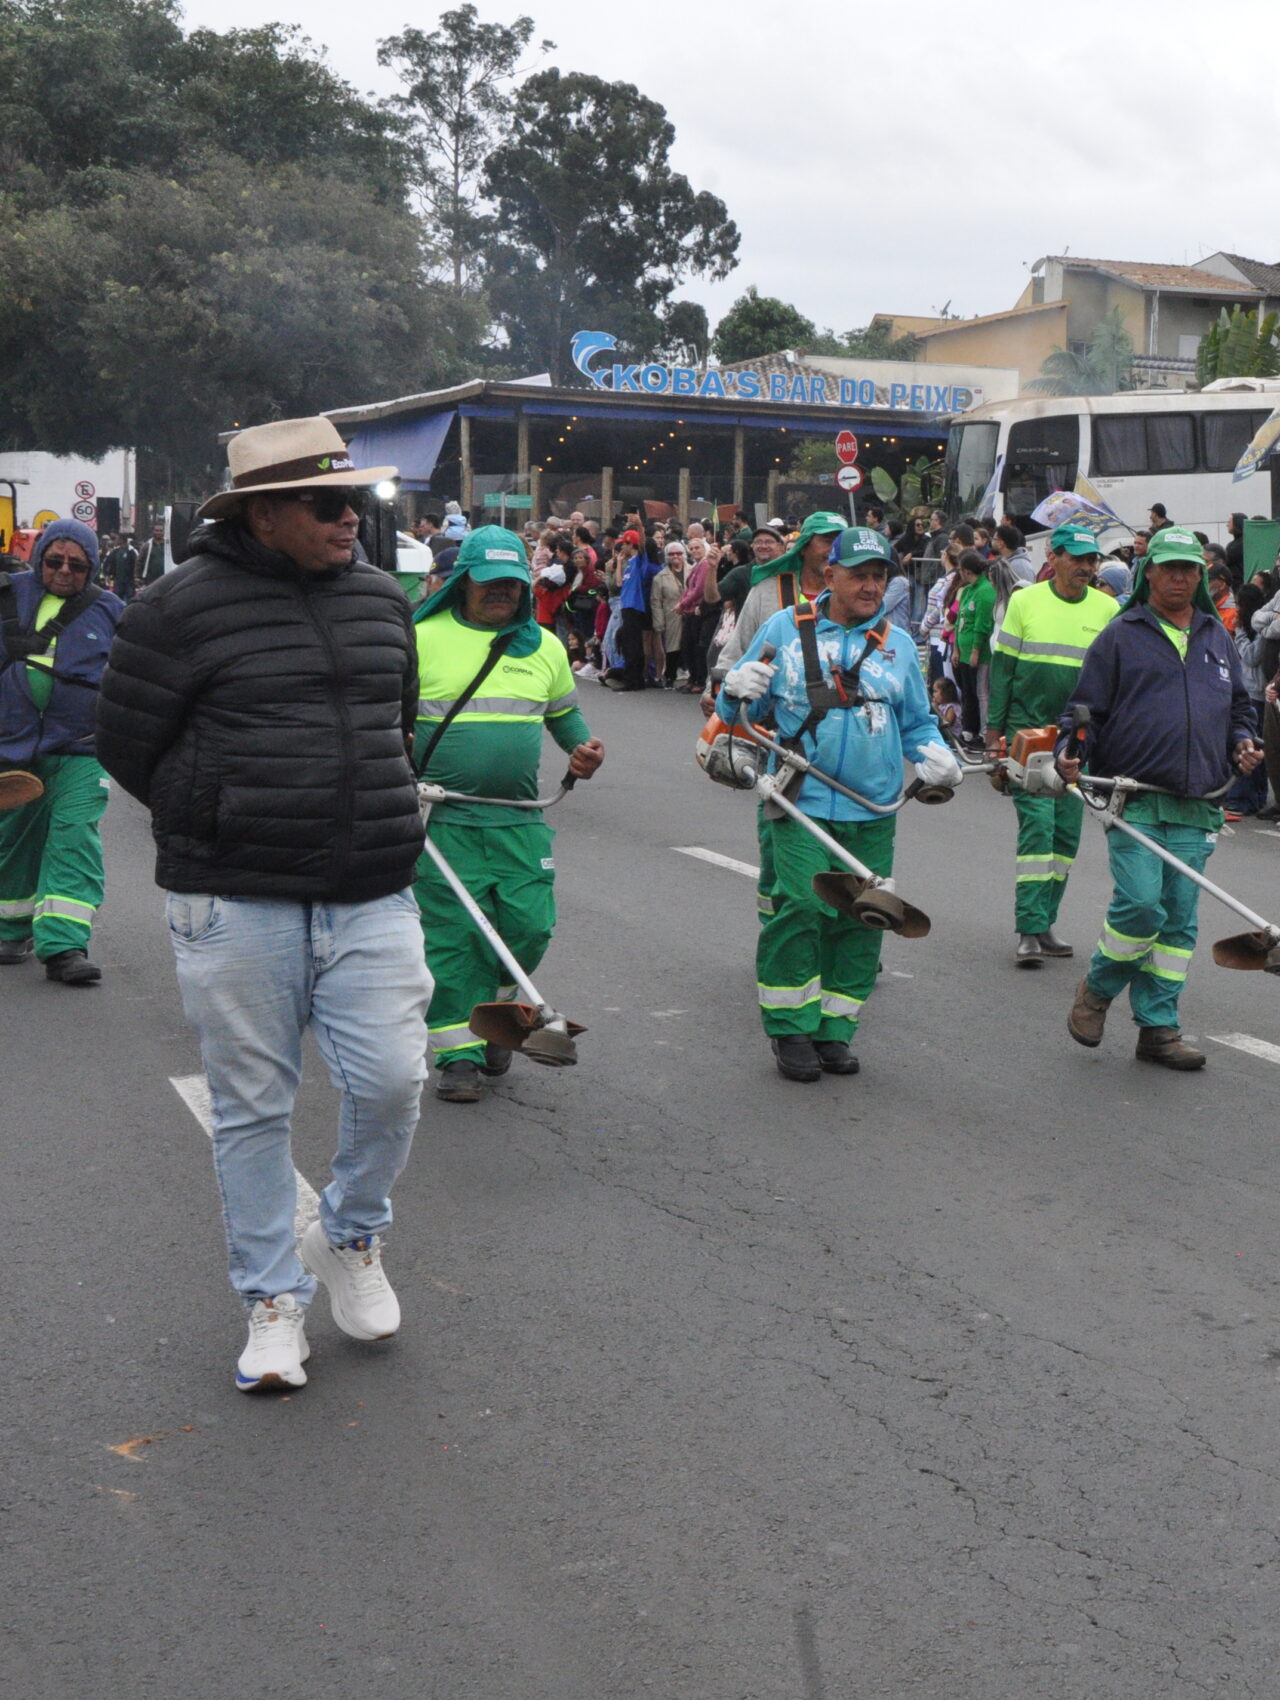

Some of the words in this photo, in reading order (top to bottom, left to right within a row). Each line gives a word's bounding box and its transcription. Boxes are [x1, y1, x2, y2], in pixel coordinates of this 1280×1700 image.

[612, 364, 761, 398] KOBA'S
[769, 373, 826, 403] BAR
[838, 378, 876, 406] DO
[889, 382, 967, 412] PEIXE
[838, 442, 857, 452] PARE
[76, 505, 93, 516] 60
